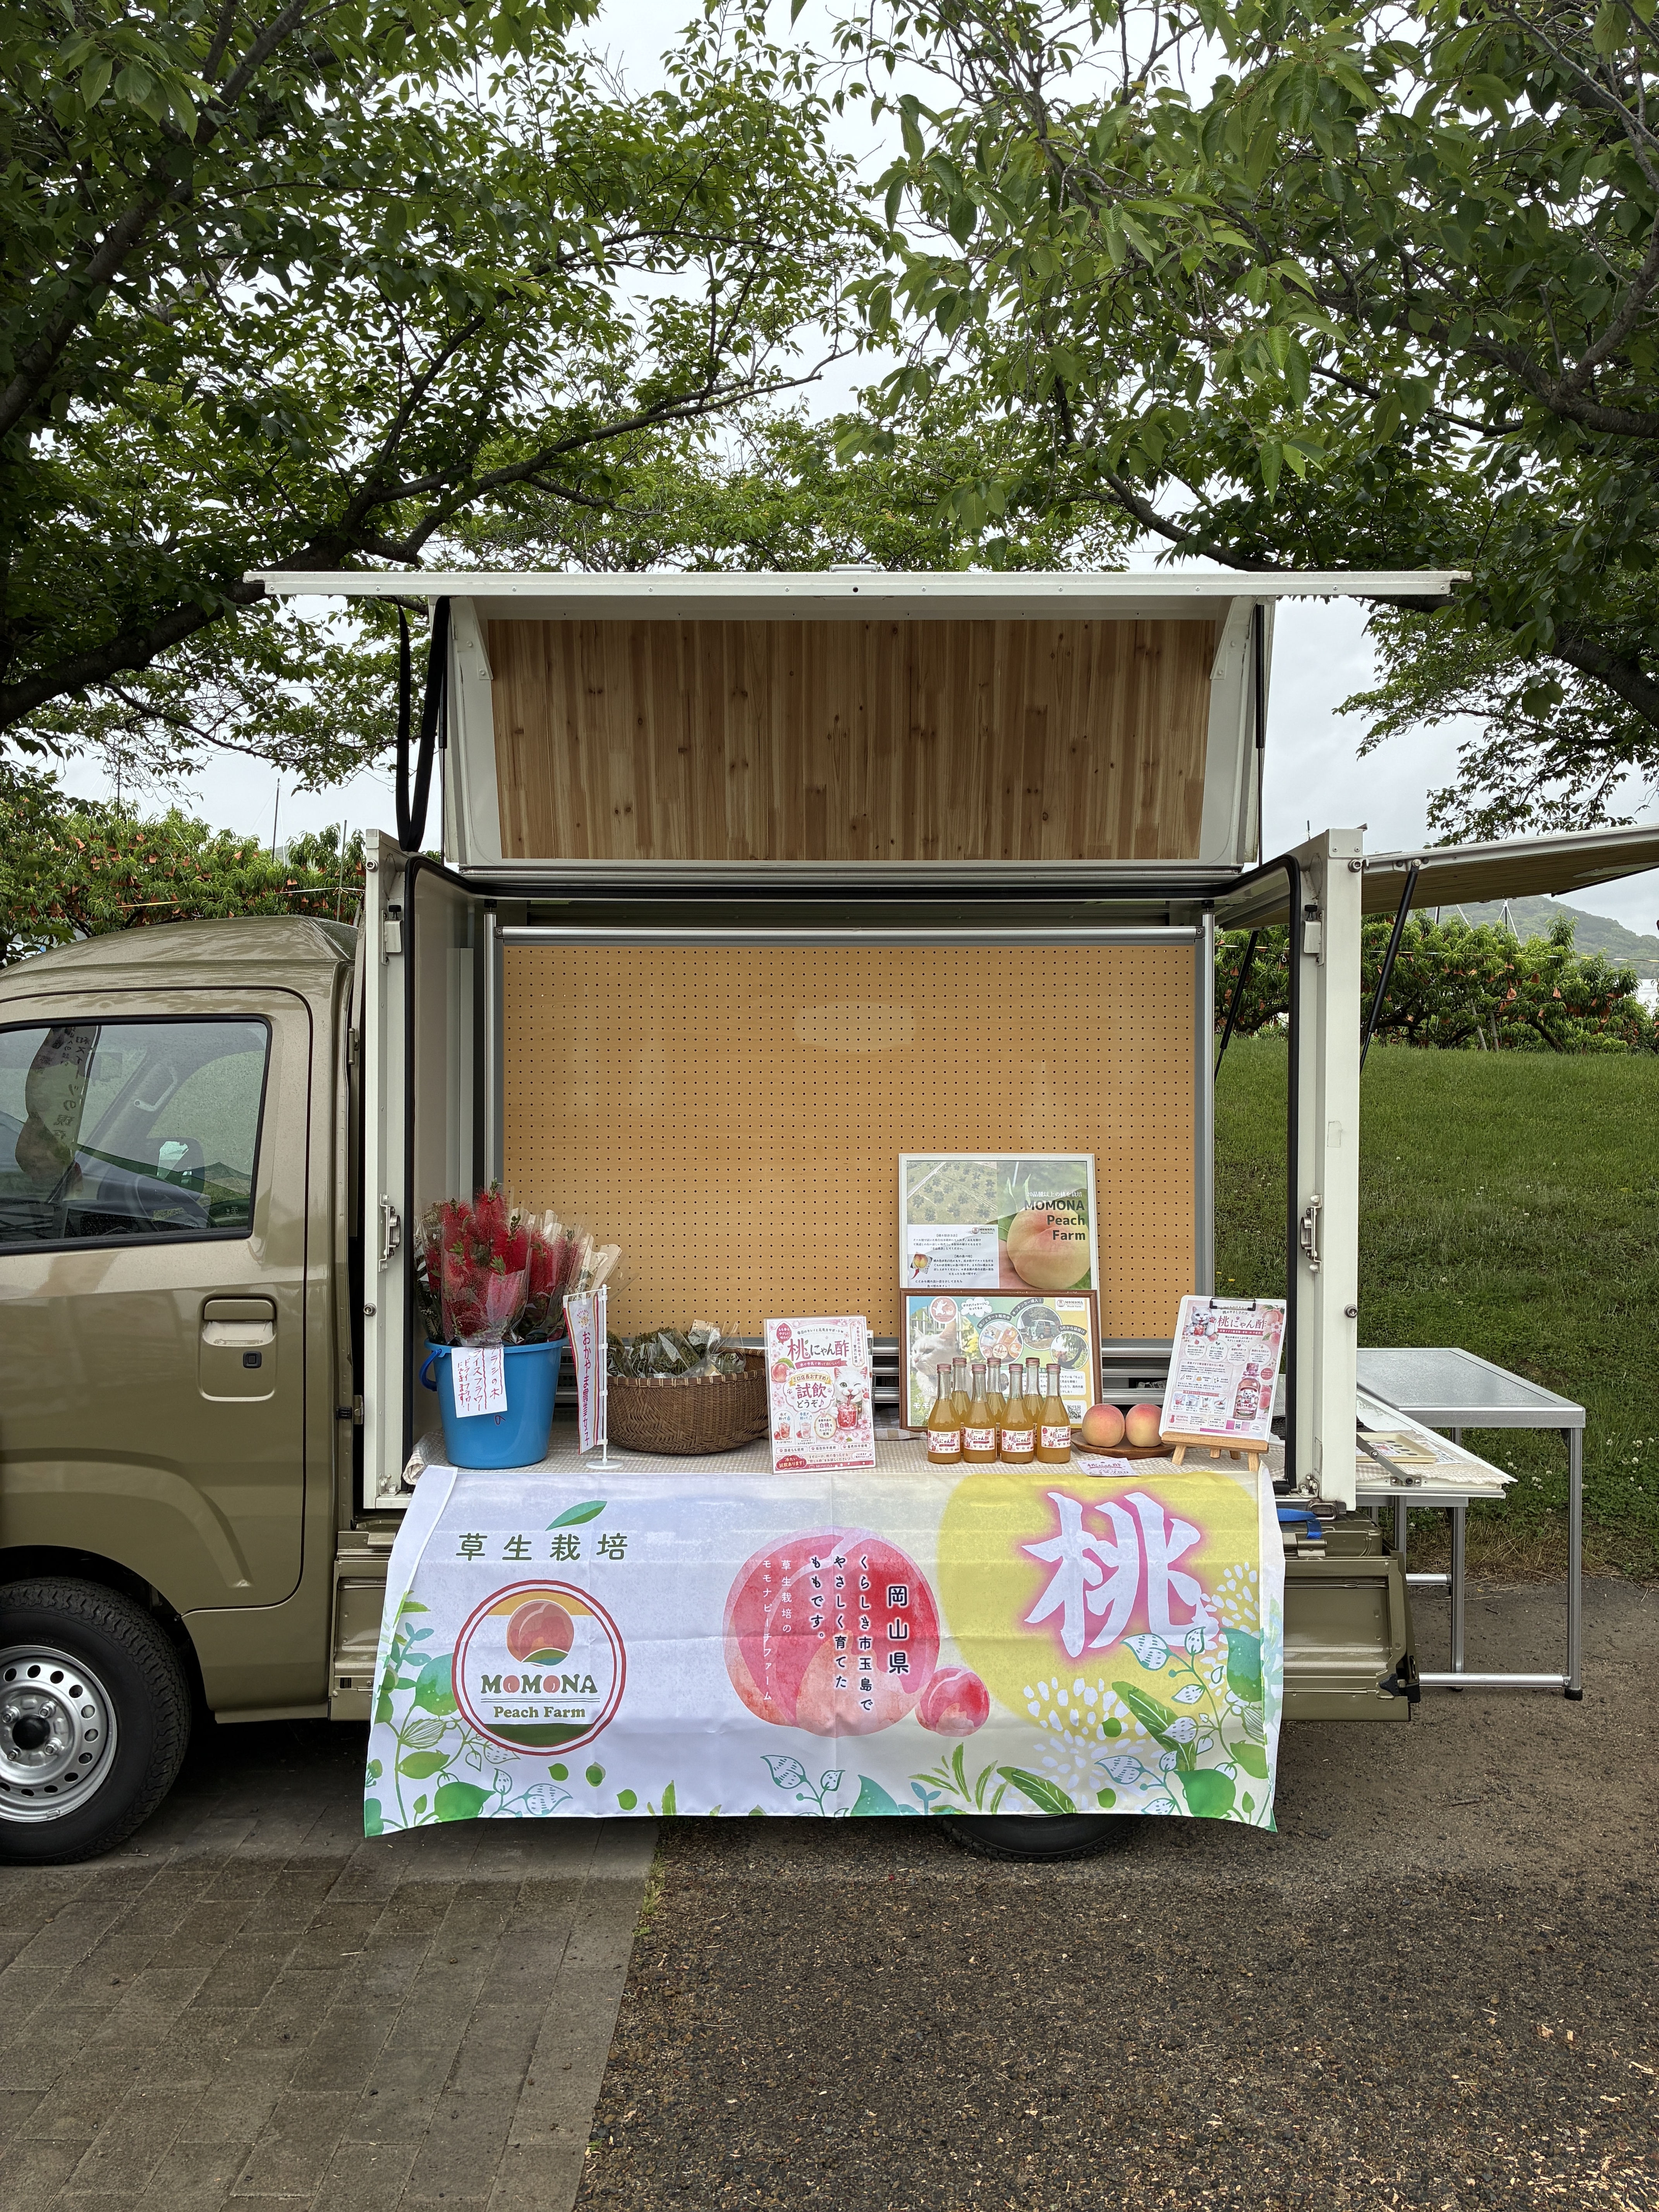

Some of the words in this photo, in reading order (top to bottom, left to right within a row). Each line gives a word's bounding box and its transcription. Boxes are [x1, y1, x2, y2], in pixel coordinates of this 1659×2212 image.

[1024, 1200, 1085, 1211] MOMONA
[1047, 1215, 1085, 1225] Peach
[1053, 1230, 1085, 1240] Farm
[1218, 1316, 1267, 1329] 桃にゃん酢
[787, 1338, 849, 1362] 桃にゃん酢
[473, 1349, 483, 1411] ライスフラワー
[795, 1382, 827, 1399] 試飲
[456, 1533, 628, 1561] 草生栽培
[1022, 1492, 1219, 1657] 桃
[781, 1560, 792, 1633] 草生栽培の
[811, 1556, 824, 1638] ももです。
[763, 1561, 772, 1700] モモナピーチファーム
[833, 1556, 847, 1688] やさしく育てた
[859, 1556, 873, 1711] くらしき市玉島で
[888, 1585, 909, 1674] 岡山県
[481, 1673, 598, 1694] MOMONA
[493, 1706, 539, 1717] Peach
[544, 1706, 586, 1717] Farm
